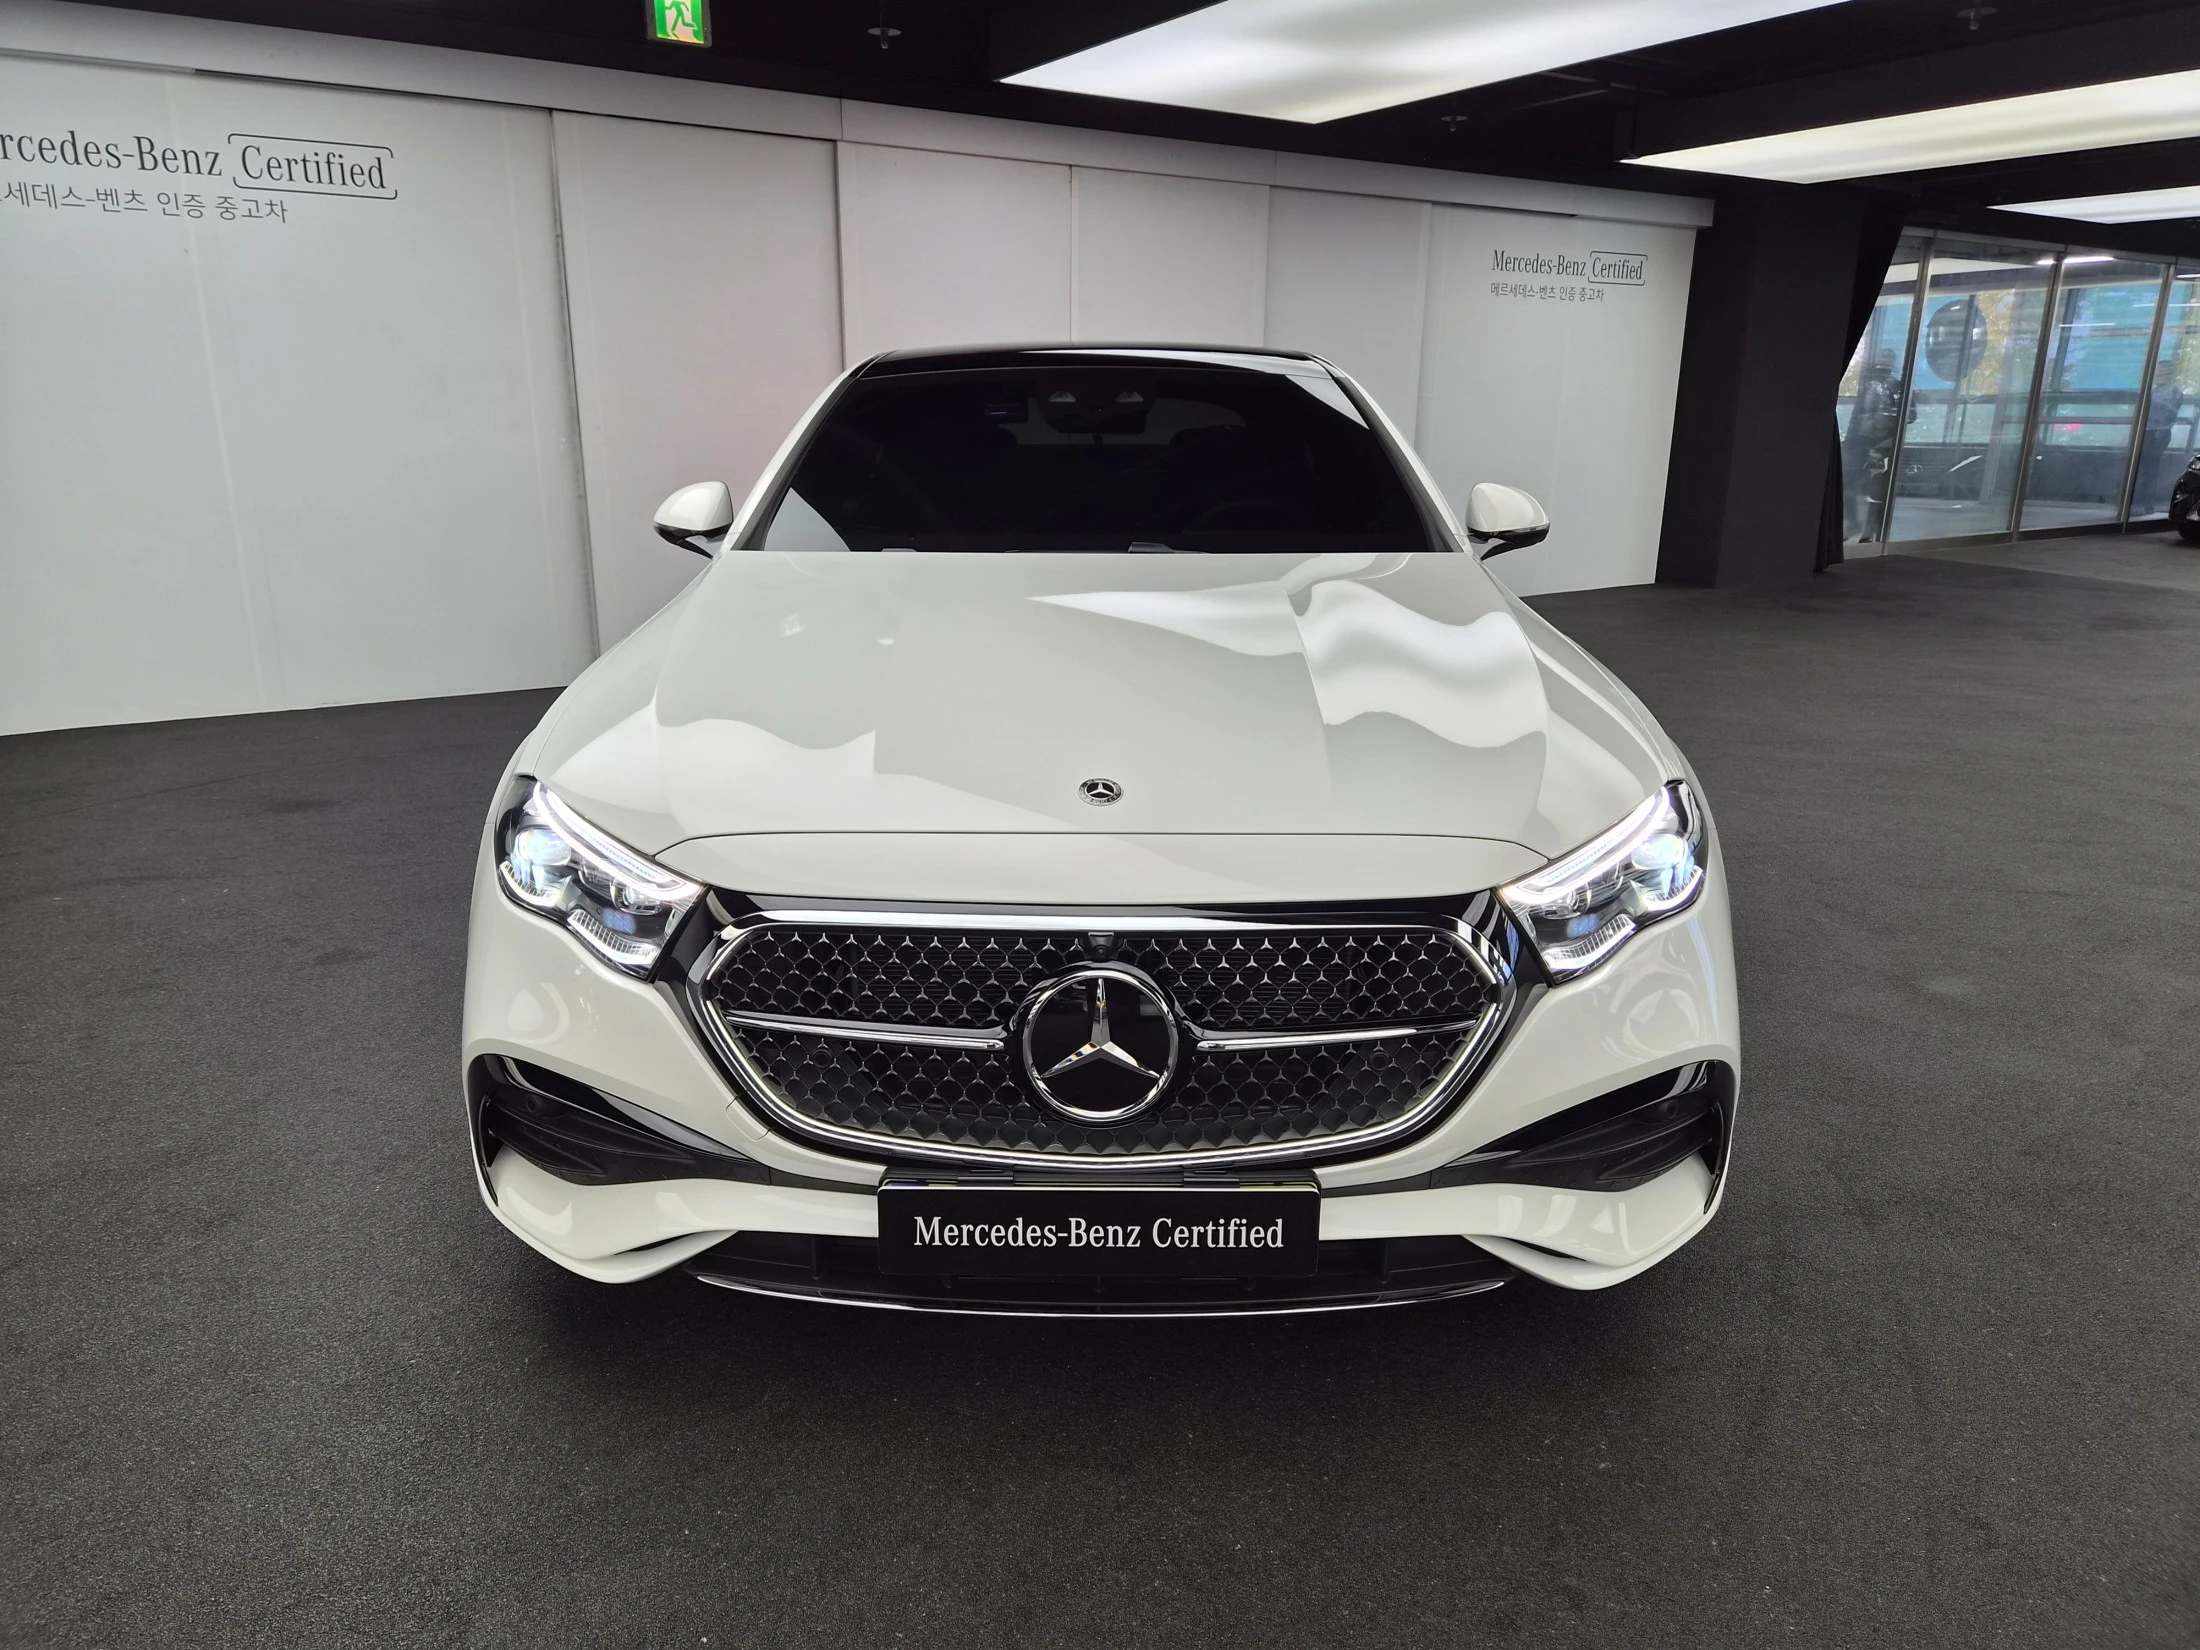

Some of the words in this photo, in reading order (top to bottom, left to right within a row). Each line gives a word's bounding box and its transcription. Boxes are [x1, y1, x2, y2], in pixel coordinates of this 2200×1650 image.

[241, 145, 387, 189] Certified
[0, 181, 148, 213] 세데스-벤츠
[156, 192, 206, 219] 인증
[215, 195, 288, 223] 중고차
[1492, 250, 1586, 276] Mercedes-Benz
[1592, 257, 1643, 280] Certified
[1490, 282, 1556, 299] 메르세데스-벤츠
[1559, 286, 1576, 301] 인증
[1579, 287, 1604, 302] 중고차
[914, 1216, 1141, 1248] Mercedes-Benz
[1152, 1217, 1284, 1248] Certified
